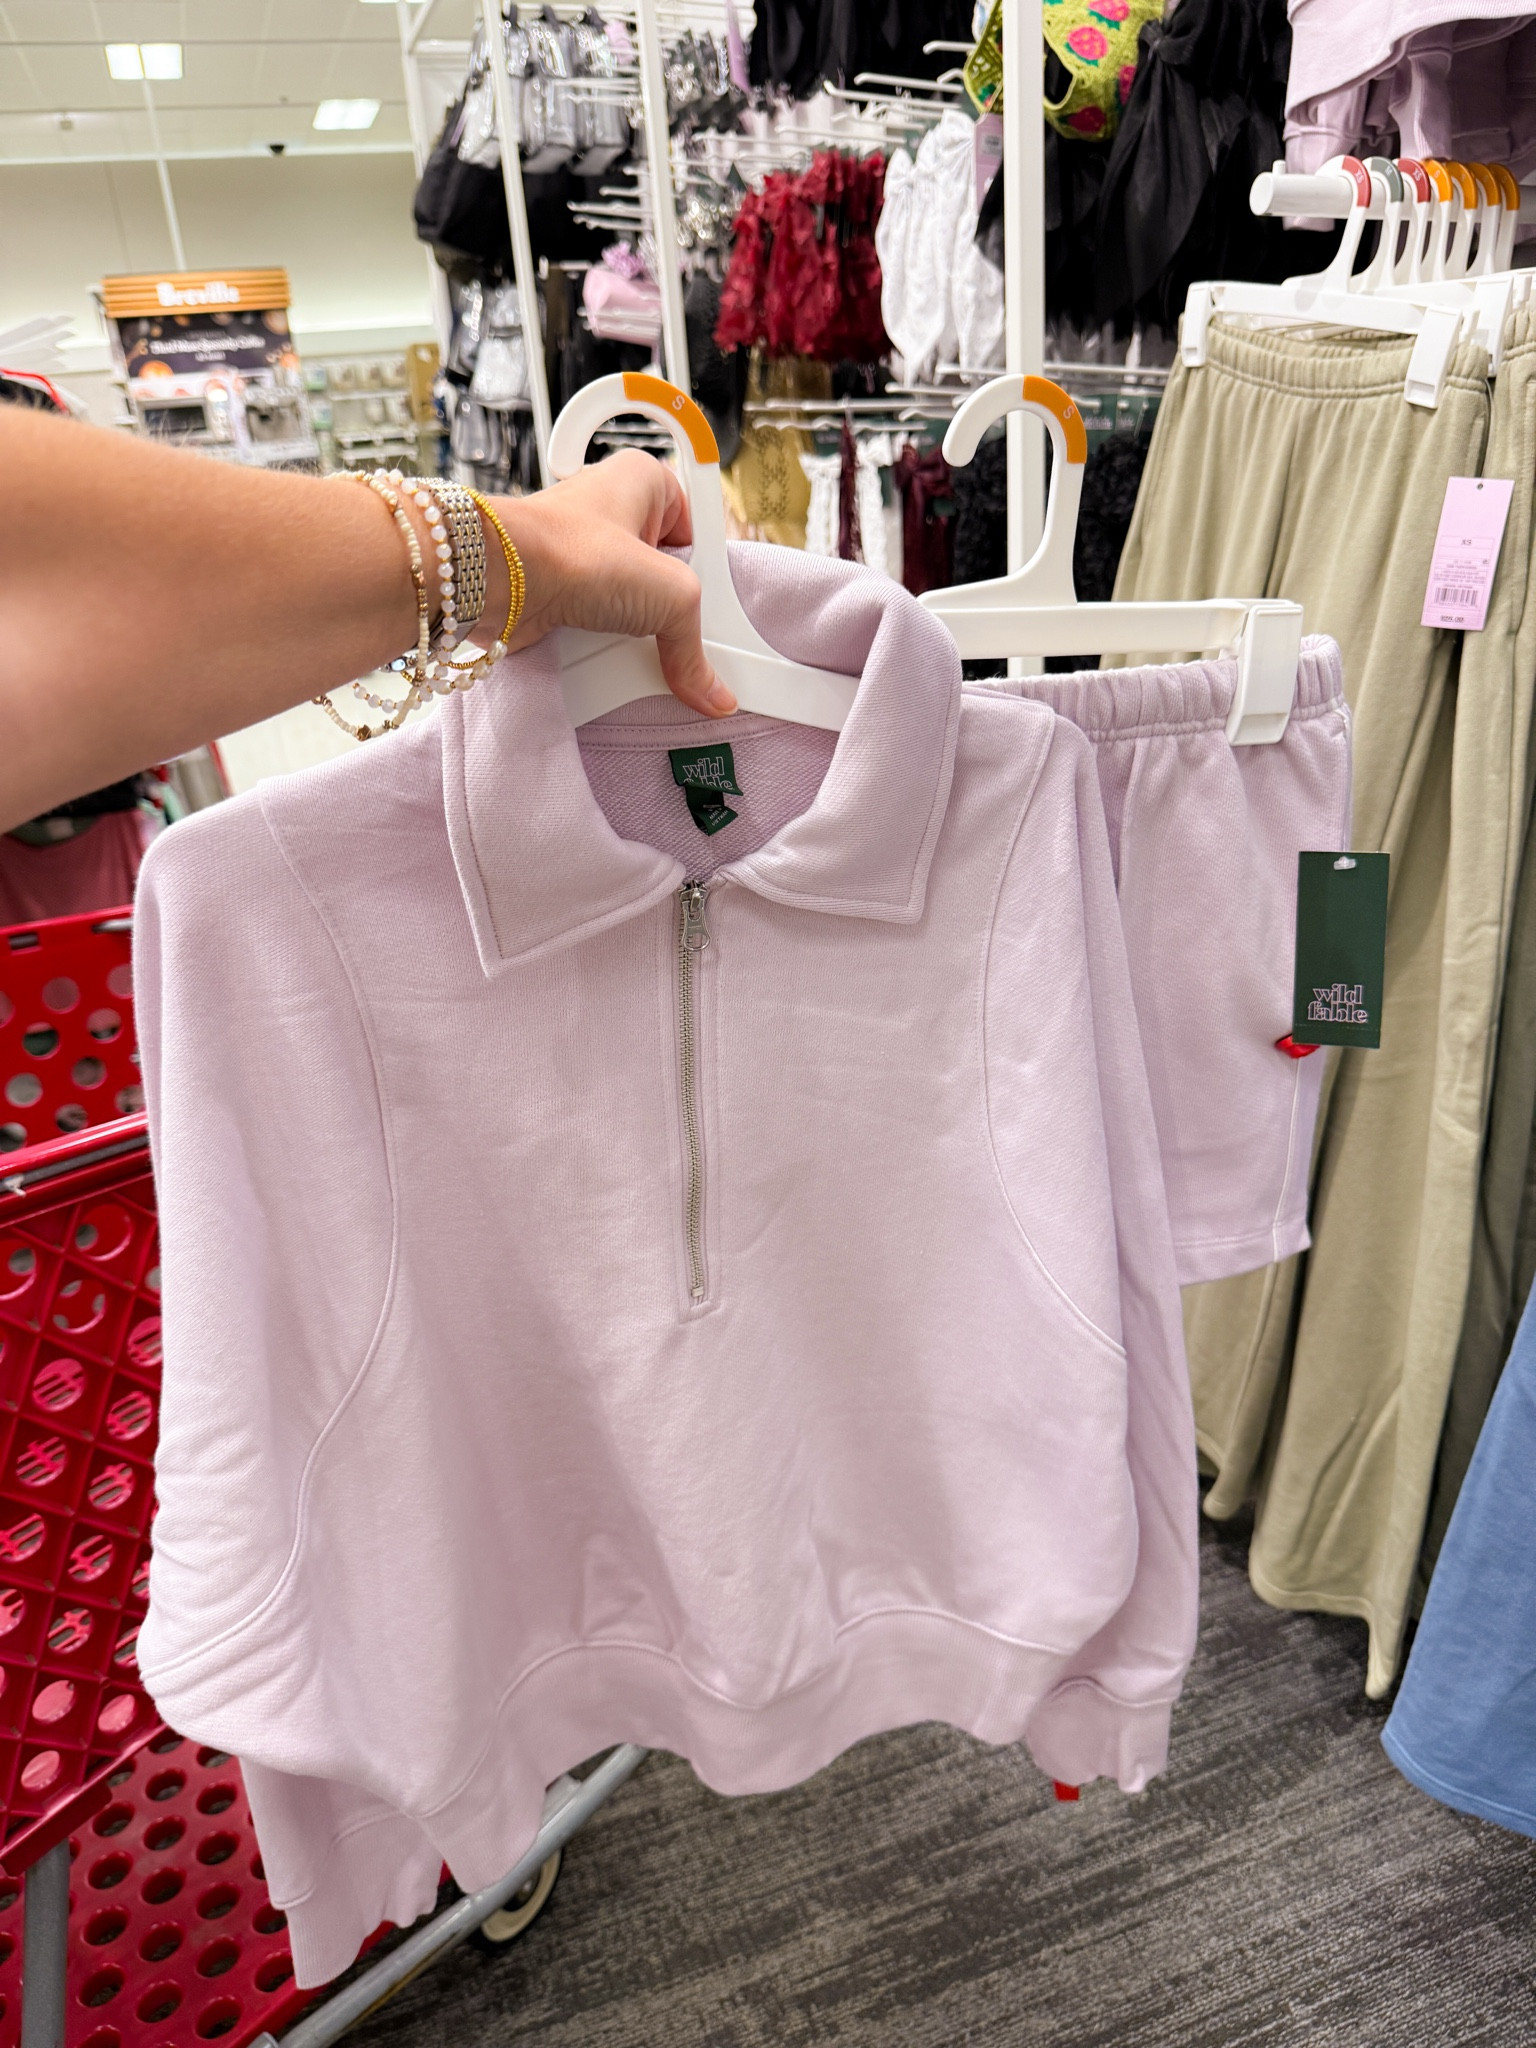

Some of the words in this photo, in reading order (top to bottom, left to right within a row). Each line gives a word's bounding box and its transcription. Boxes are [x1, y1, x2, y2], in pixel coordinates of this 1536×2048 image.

[671, 394, 685, 411] S
[1063, 405, 1076, 420] S
[682, 756, 725, 779] wild
[1312, 983, 1363, 1005] wild
[1307, 1001, 1368, 1024] fable
